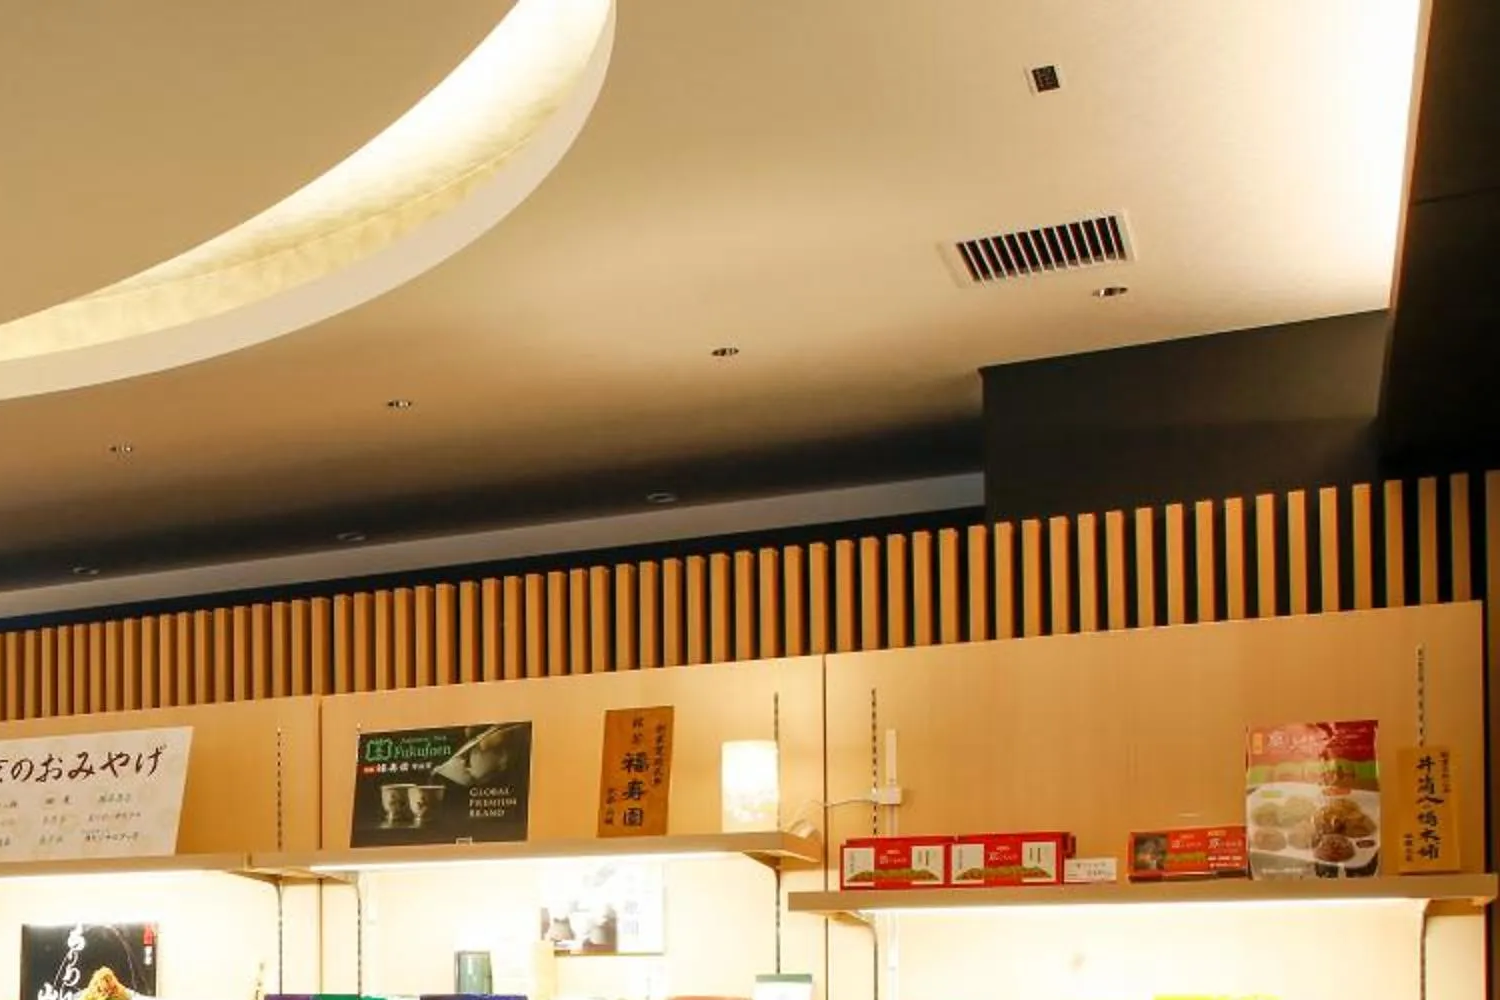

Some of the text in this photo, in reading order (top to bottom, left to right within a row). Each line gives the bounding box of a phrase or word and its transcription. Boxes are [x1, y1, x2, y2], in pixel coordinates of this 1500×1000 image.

[469, 786, 514, 797] GLOBAL
[469, 798, 517, 808] PREMIUM
[469, 809, 505, 818] BRAND
